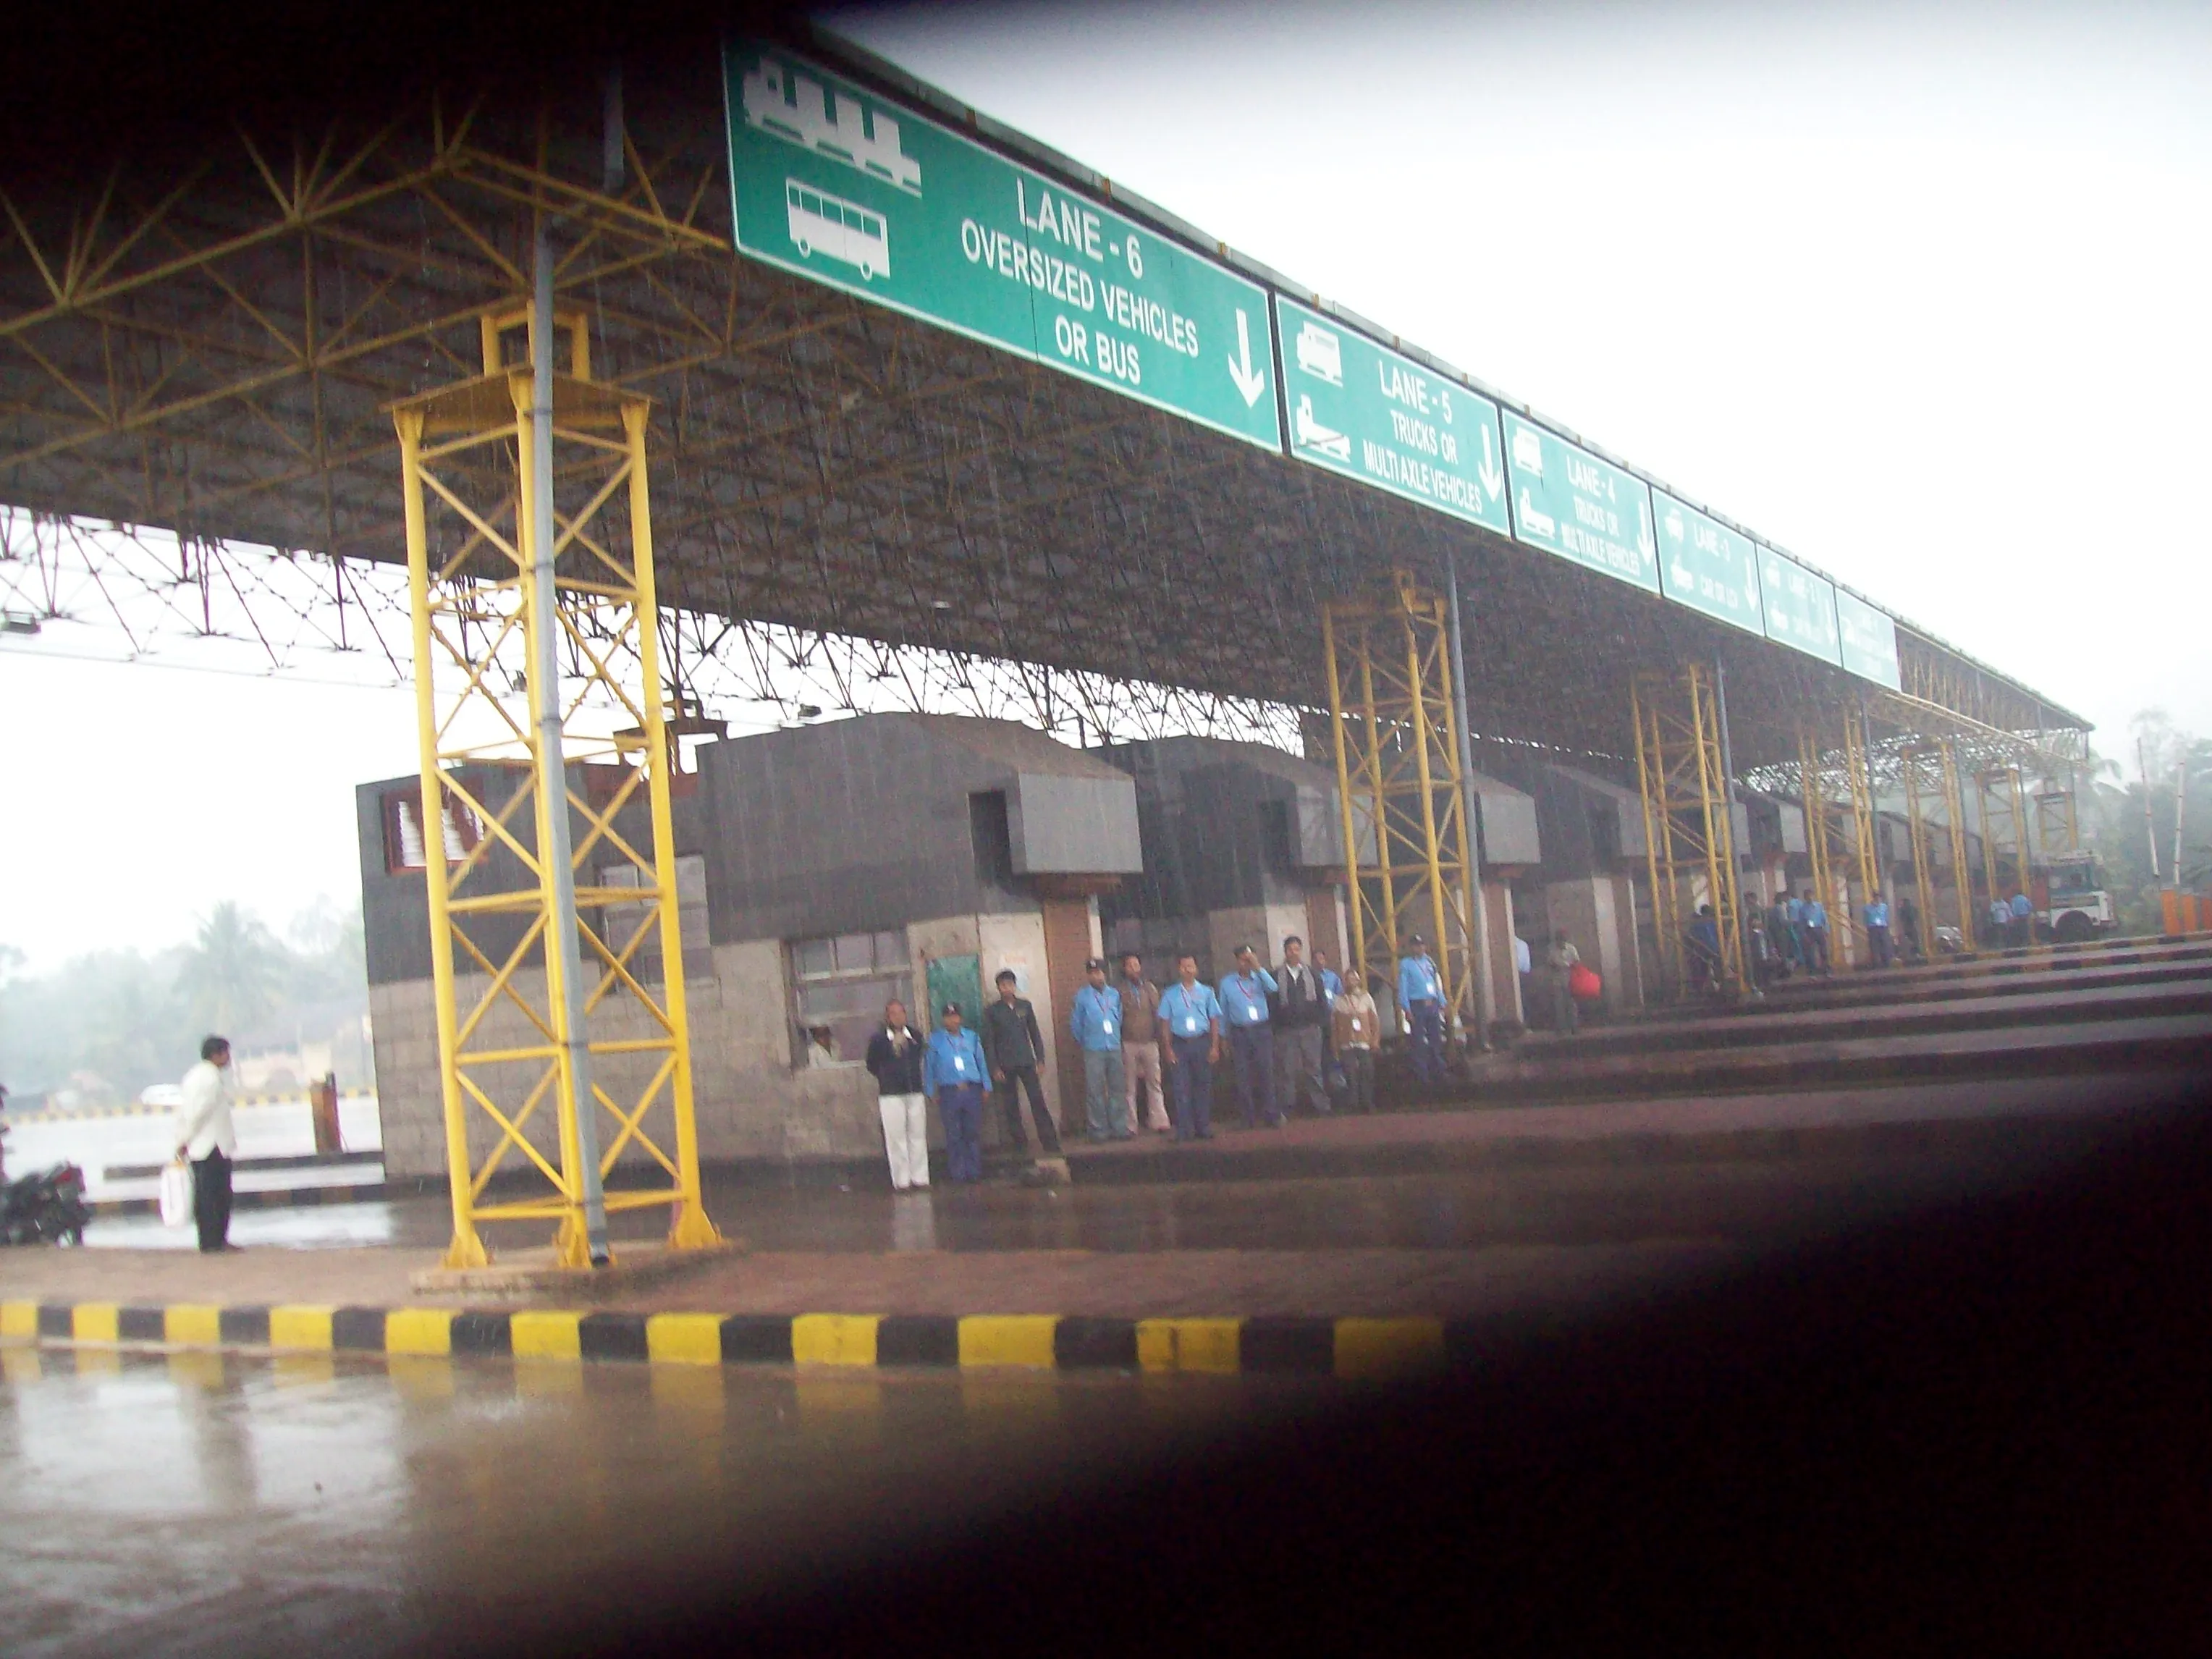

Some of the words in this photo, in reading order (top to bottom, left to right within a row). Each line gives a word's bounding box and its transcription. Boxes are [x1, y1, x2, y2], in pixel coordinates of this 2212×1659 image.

[1017, 177, 1104, 263] LANE
[1126, 234, 1144, 280] 6
[961, 218, 1095, 313] OVERSIZED
[1099, 279, 1200, 358] VEHICLES
[1055, 314, 1090, 366] OR
[1096, 331, 1141, 385] BUS
[1378, 359, 1430, 415] LANE
[1442, 392, 1452, 424] 5
[1390, 408, 1439, 457] TRUCKS
[1440, 431, 1459, 465] OR
[1431, 468, 1482, 515] VEHICLES
[1566, 453, 1602, 499] LANE
